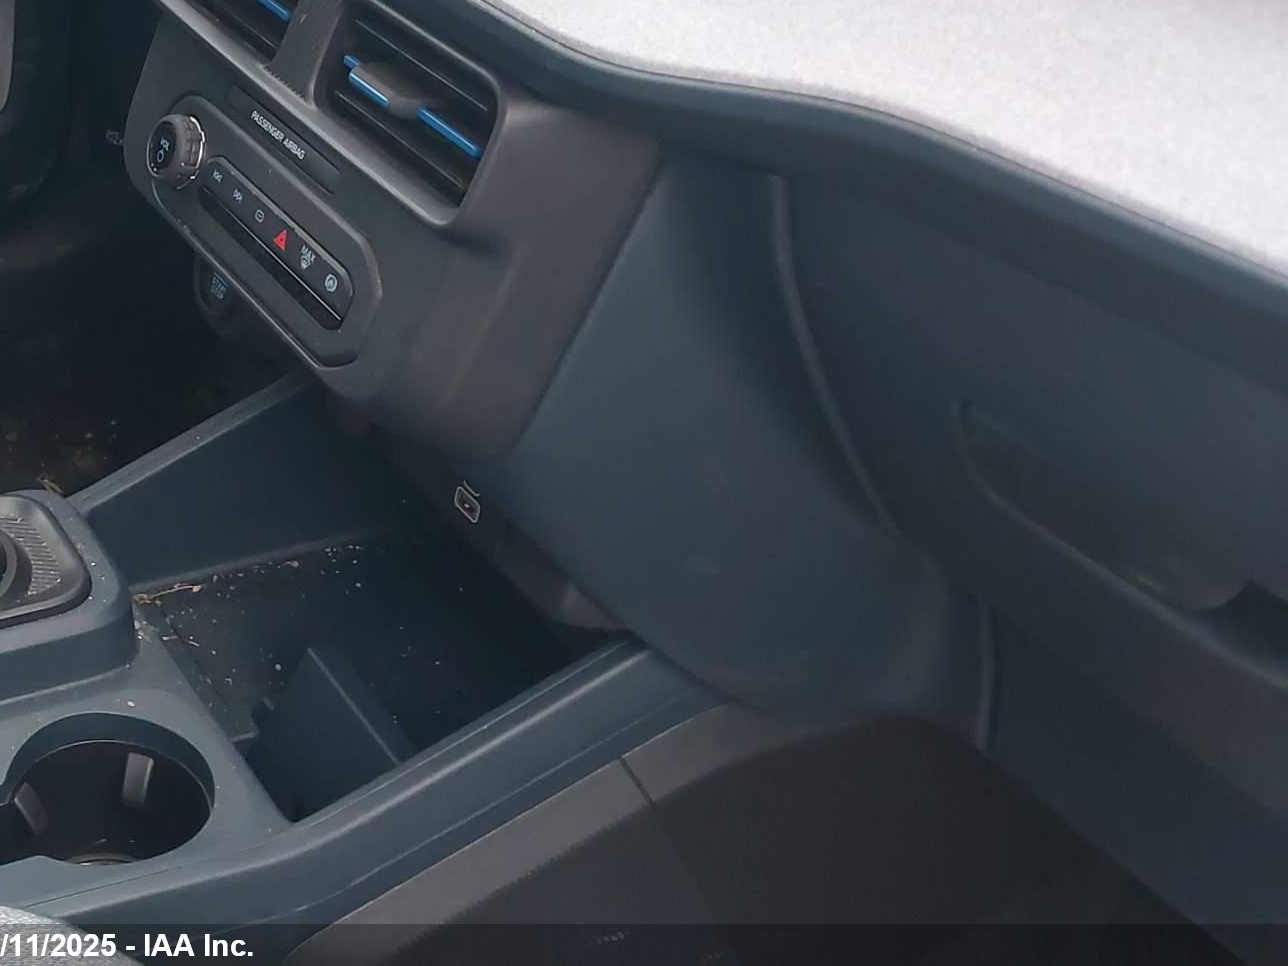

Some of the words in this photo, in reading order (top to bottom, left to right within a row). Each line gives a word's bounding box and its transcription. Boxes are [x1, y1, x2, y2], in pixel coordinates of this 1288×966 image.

[160, 136, 170, 151] VOL
[251, 110, 285, 143] PASSENGER
[283, 138, 306, 160] AIRBAG
[301, 244, 316, 263] MAX
